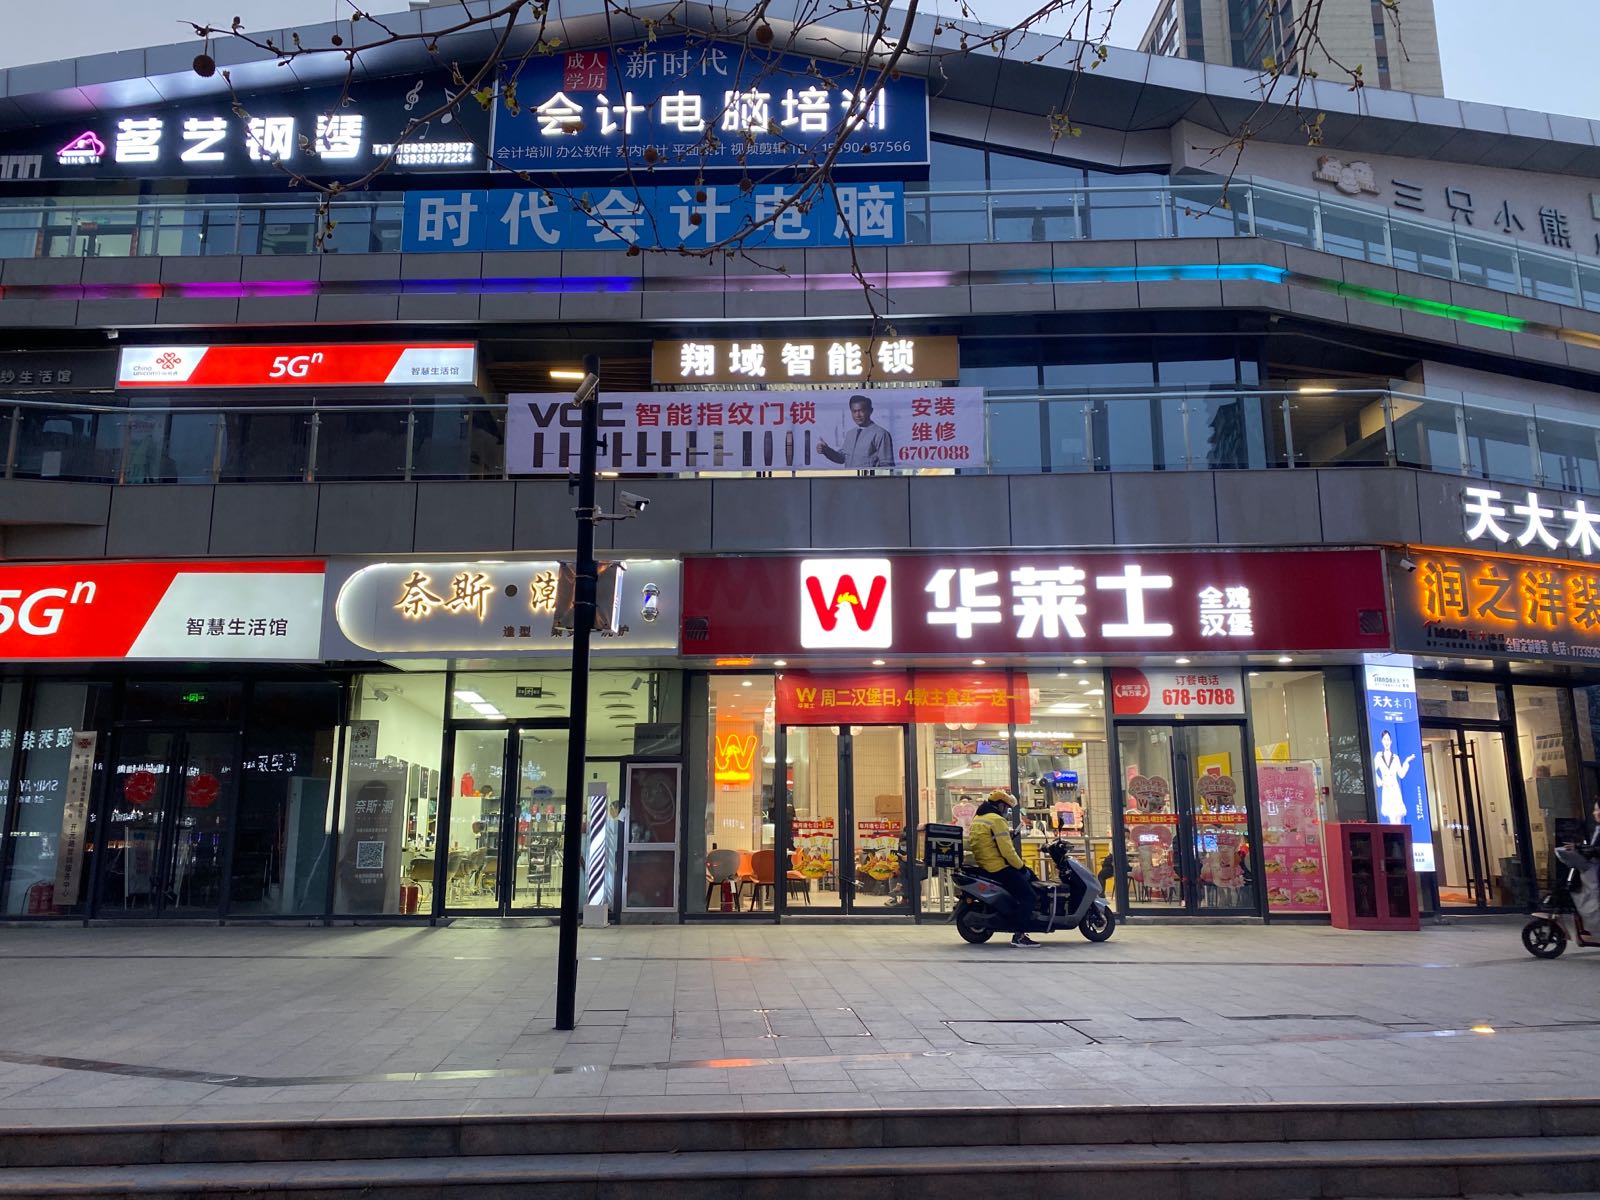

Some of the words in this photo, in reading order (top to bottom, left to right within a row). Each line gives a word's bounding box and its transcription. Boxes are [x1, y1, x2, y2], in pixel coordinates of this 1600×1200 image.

[566, 53, 605, 70] 成人
[625, 49, 729, 80] 新时代
[566, 72, 605, 90] 学历
[537, 88, 886, 136] 会计电脑培训
[115, 115, 364, 163] 茗艺钢琴
[497, 145, 553, 160] 会计培训
[556, 144, 612, 159] 办公软件
[418, 187, 895, 247] 时代会计电脑
[1392, 179, 1600, 256] 三只小熊
[680, 340, 914, 376] 翔域智能锁
[411, 366, 459, 376] 智慧生活馆
[635, 401, 816, 427] 智能指纹门锁
[911, 396, 956, 418] 安装
[911, 422, 956, 442] 维修
[899, 445, 970, 461] 6707088
[926, 565, 1174, 640] 华莱士
[1199, 586, 1251, 609] 全鸡
[186, 617, 288, 637] 智慧生活馆
[503, 625, 532, 637] 造型
[1200, 613, 1255, 636] 汉堡
[1176, 675, 1219, 686] 订餐电话
[1162, 688, 1235, 706] 678-6788
[354, 799, 395, 814] 奈斯·潮
